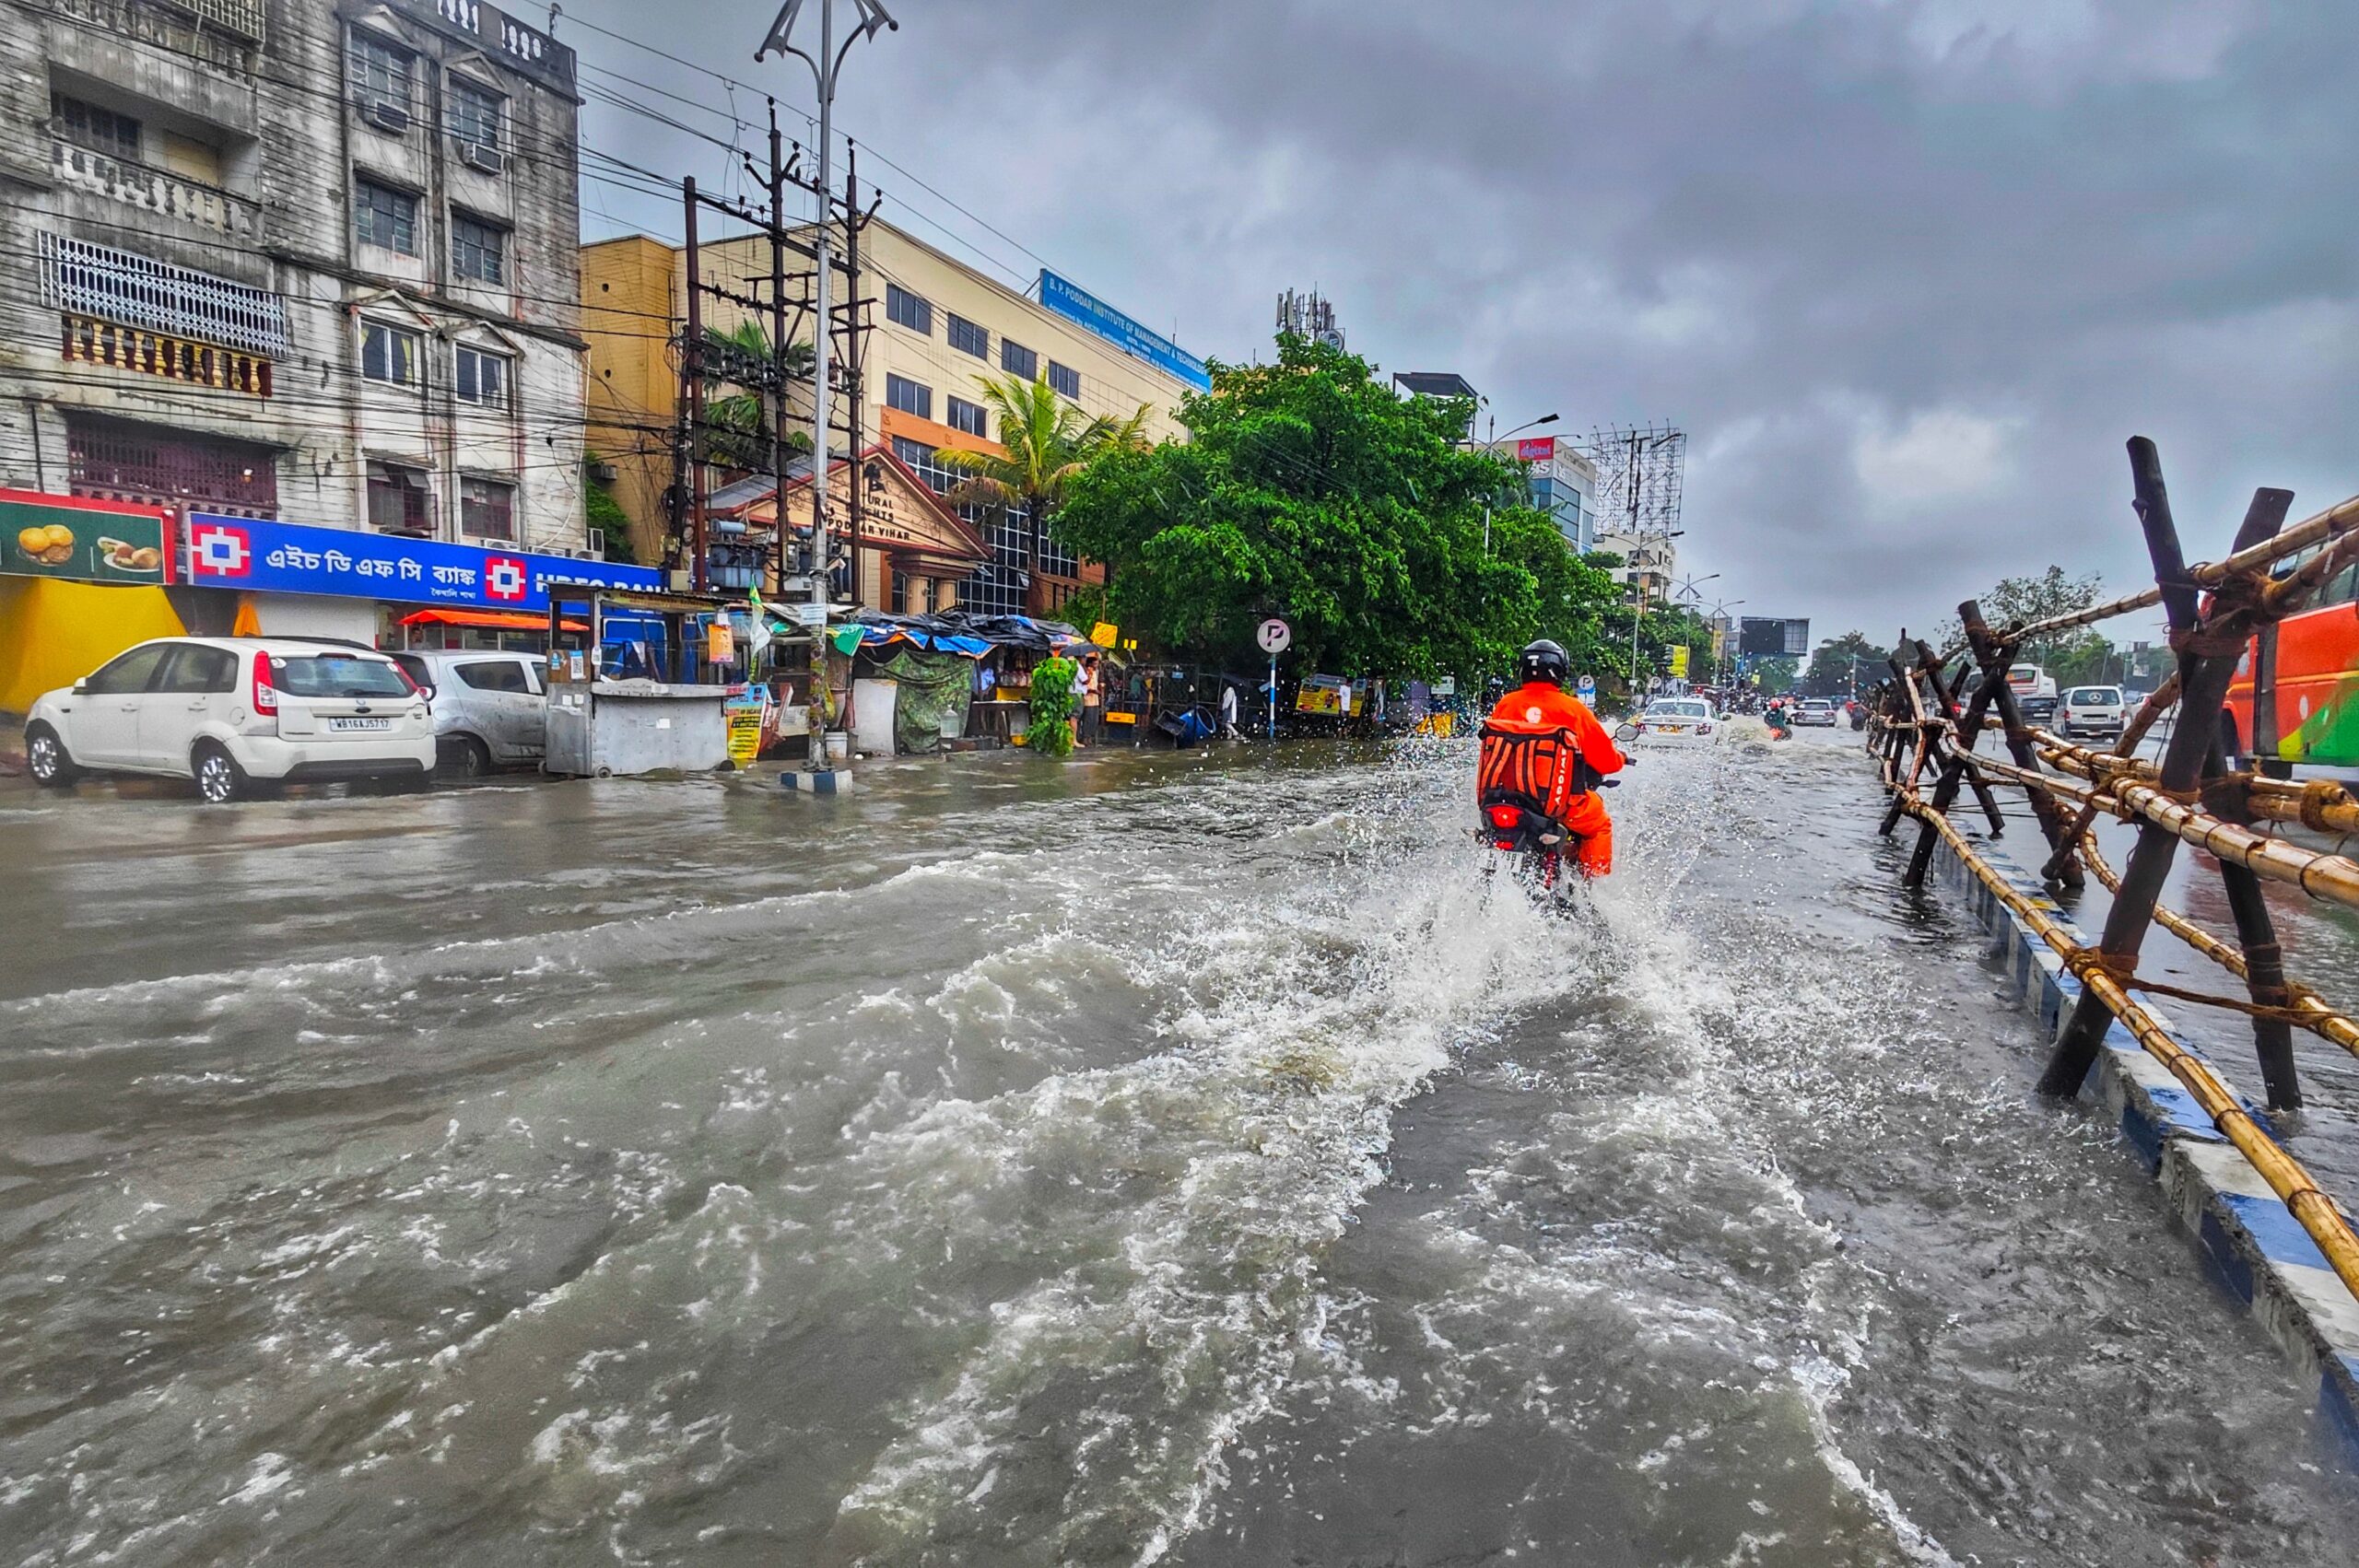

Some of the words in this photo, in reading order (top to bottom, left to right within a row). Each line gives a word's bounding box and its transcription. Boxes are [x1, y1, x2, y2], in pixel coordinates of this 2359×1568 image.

[1064, 287, 1093, 310] PODDAR
[1093, 299, 1125, 330] INSTITUTE
[1125, 321, 1134, 333] OF
[1134, 325, 1171, 357] MANAGEMENT
[828, 518, 874, 534] PODAR
[878, 526, 910, 541] VIHAR
[265, 544, 322, 569] এইচ
[323, 549, 352, 573] ডি
[356, 558, 394, 579] এফ
[398, 559, 423, 581] সি
[432, 565, 476, 586] ব্যাঙ্ক
